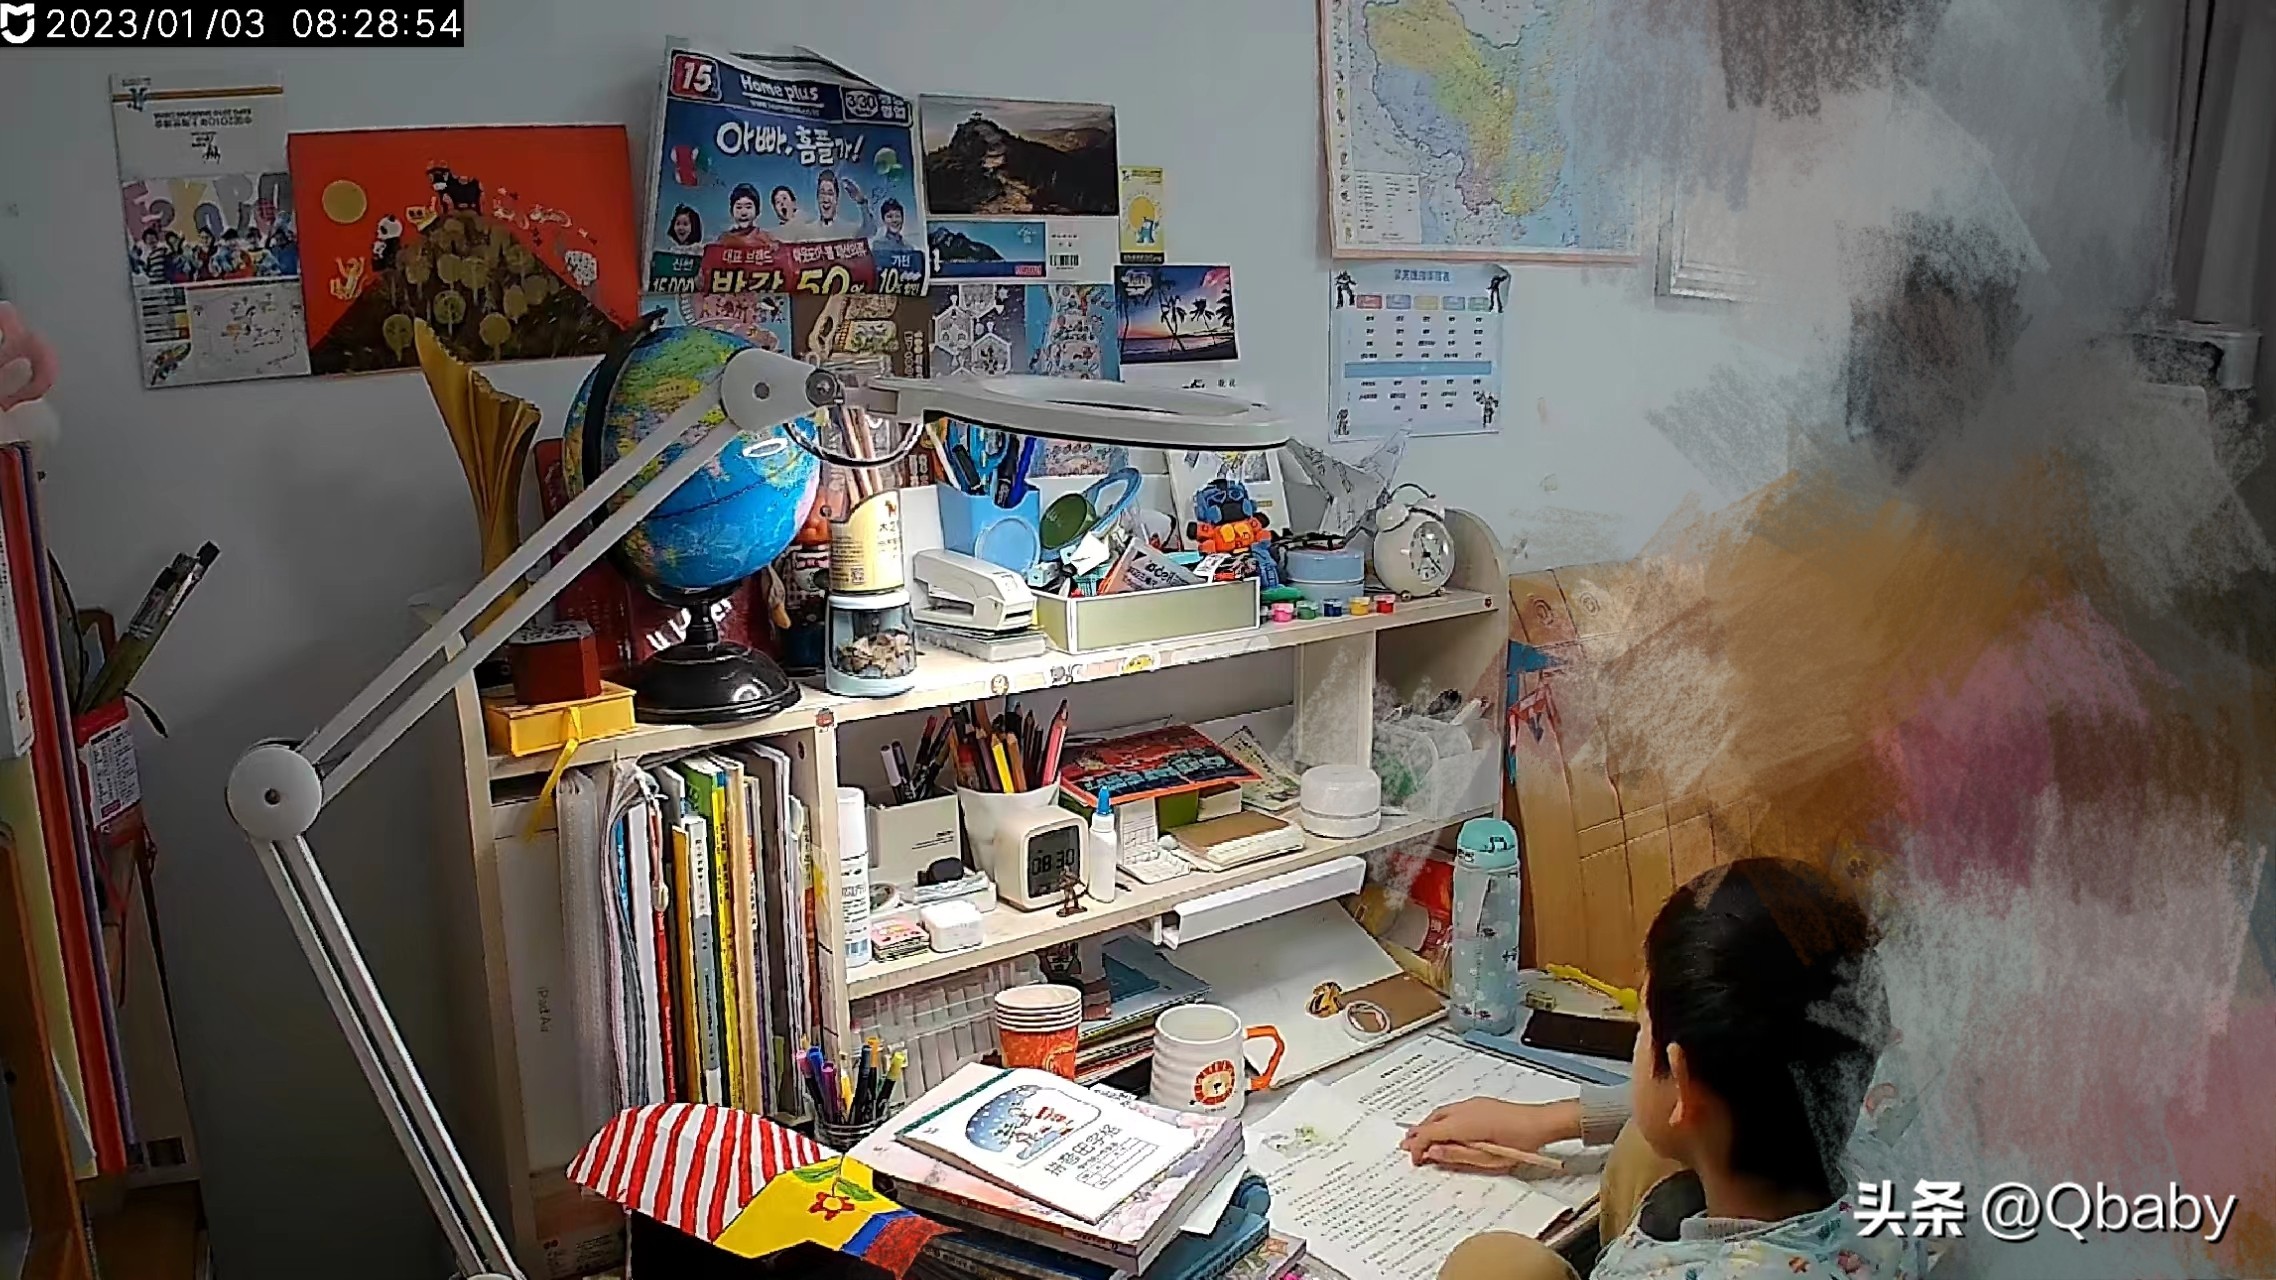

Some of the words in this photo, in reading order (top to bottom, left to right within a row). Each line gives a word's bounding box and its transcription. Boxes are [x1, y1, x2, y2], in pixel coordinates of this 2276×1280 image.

[682, 62, 713, 93] 15
[739, 73, 784, 97] Home
[784, 84, 819, 104] plus
[716, 120, 794, 155] 아빠,
